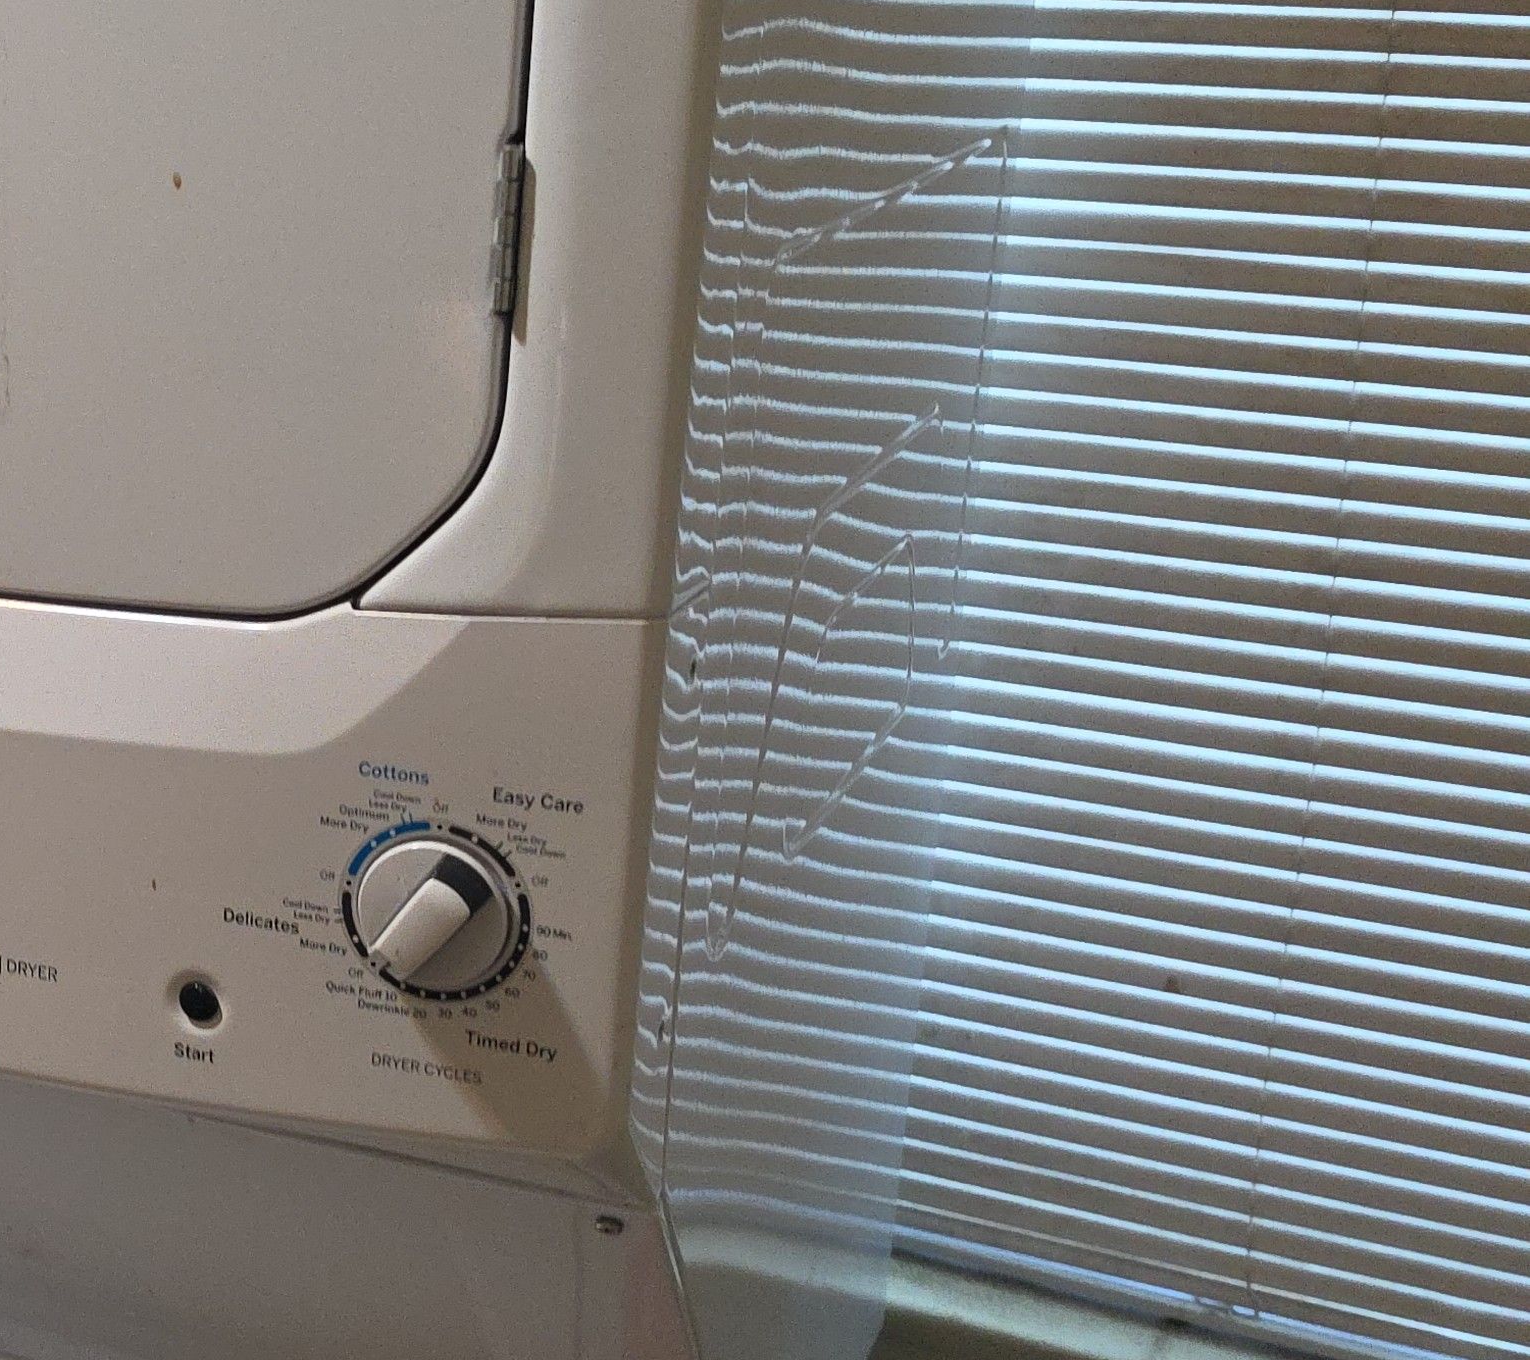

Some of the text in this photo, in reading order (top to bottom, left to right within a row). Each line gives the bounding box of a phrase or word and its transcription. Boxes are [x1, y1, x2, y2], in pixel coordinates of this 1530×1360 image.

[358, 760, 430, 787] Cottons
[492, 786, 584, 815] Easy Care
[222, 907, 301, 936] Delicates
[5, 956, 59, 983] DRYER
[173, 1041, 217, 1065] Start
[464, 1027, 558, 1064] Timed Dry
[371, 1051, 483, 1085] DRYER CYCLES
